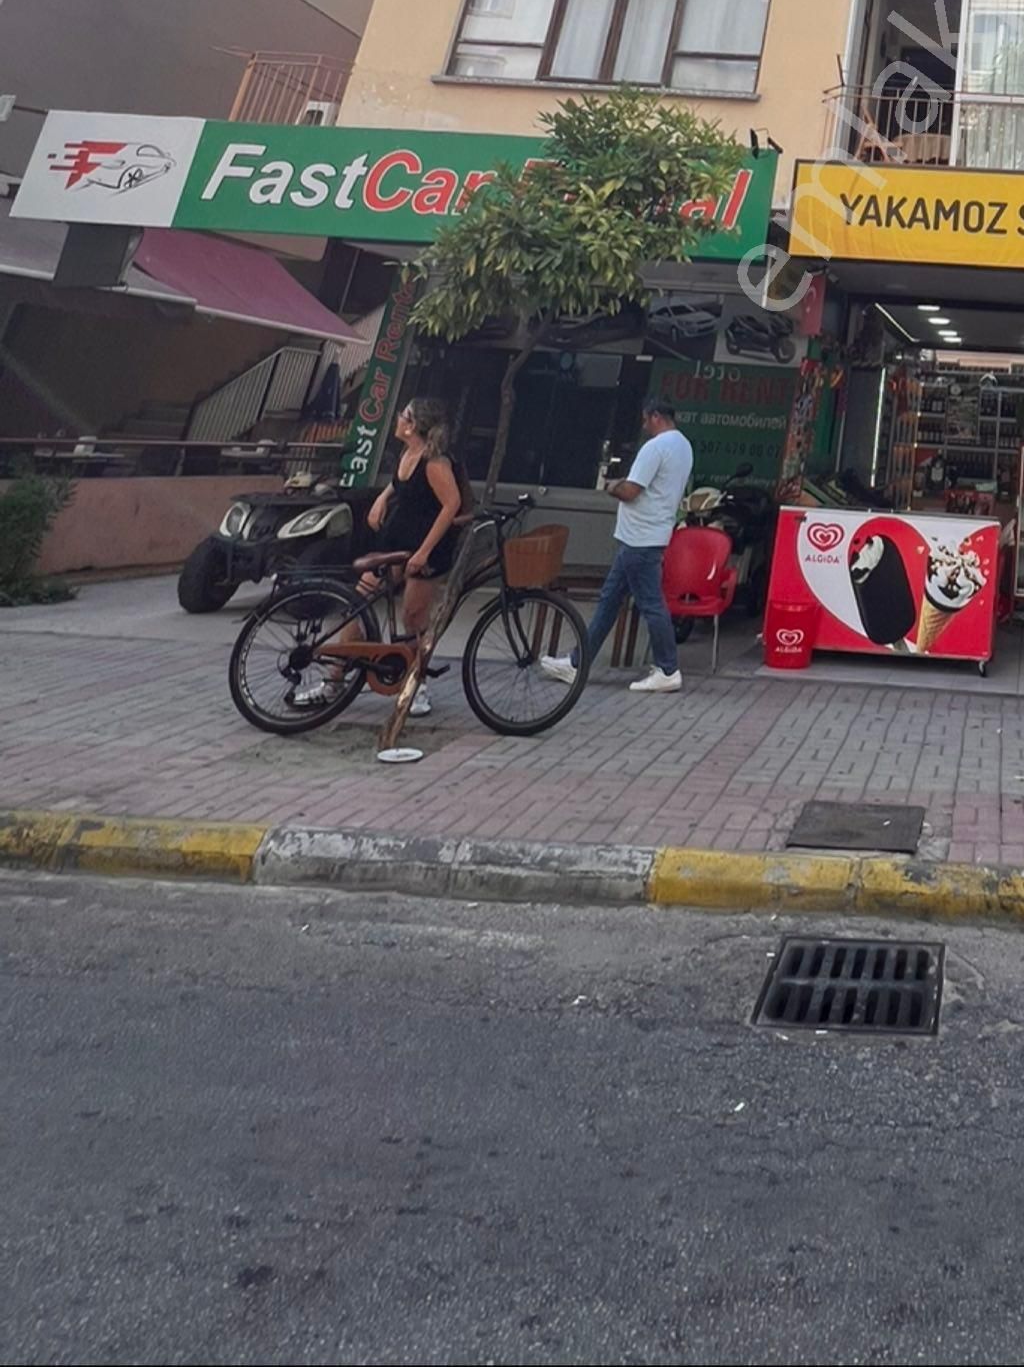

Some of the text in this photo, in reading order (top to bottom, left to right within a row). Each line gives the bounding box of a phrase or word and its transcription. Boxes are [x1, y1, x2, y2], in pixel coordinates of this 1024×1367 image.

[838, 192, 1008, 235] YAKAMOZ
[360, 367, 391, 422] Car
[661, 371, 709, 402] FOR
